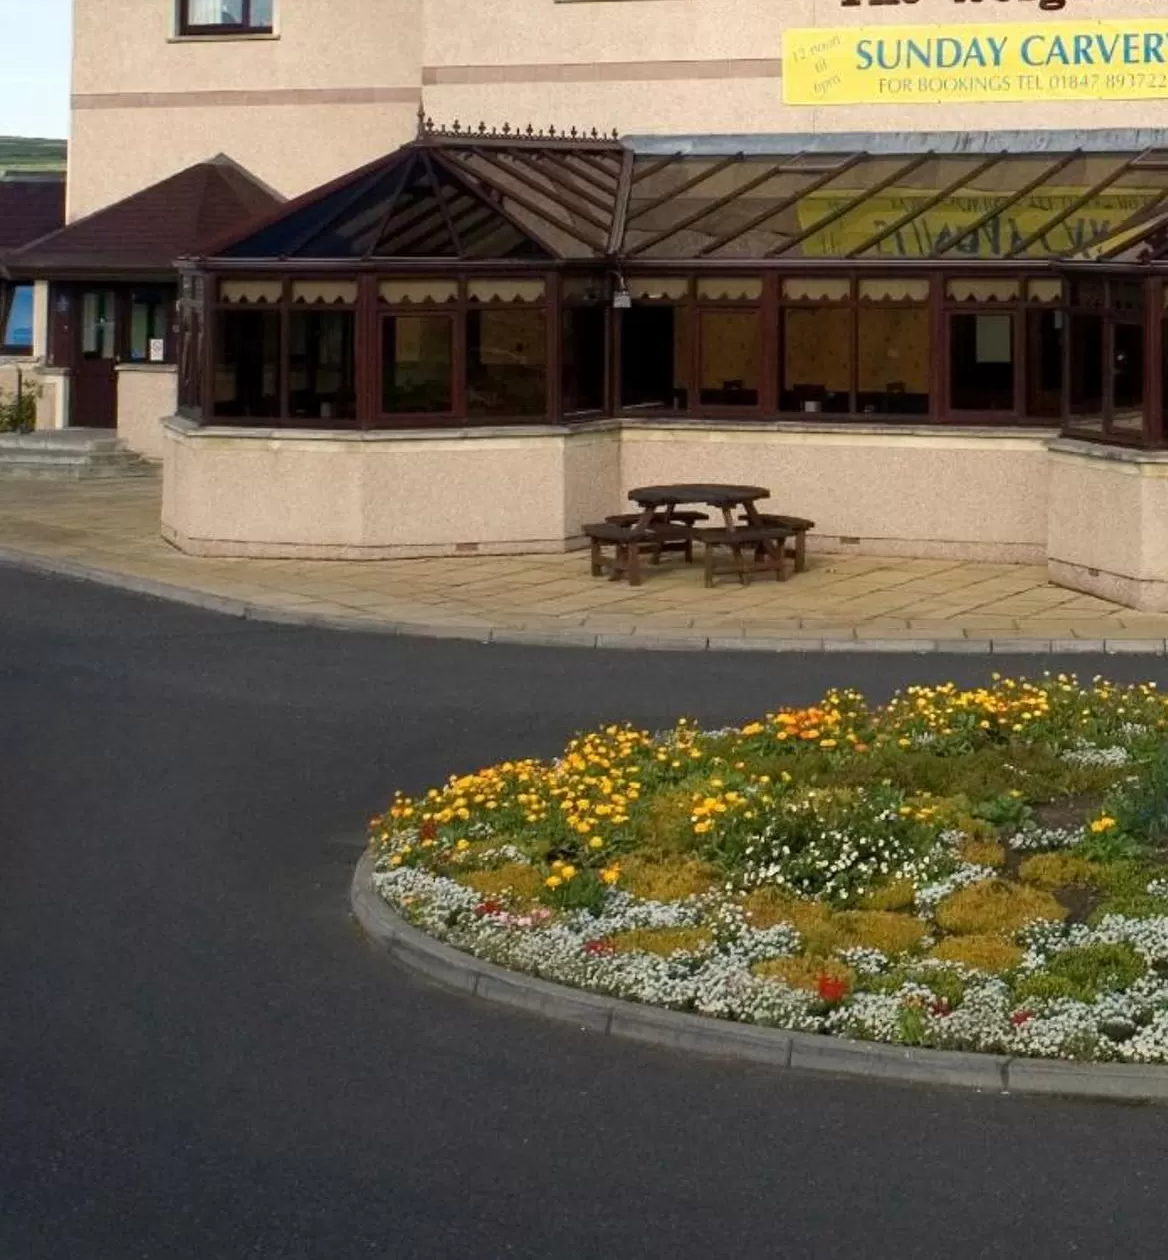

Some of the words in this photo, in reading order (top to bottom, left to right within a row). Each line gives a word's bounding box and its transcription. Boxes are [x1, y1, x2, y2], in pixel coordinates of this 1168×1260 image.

[856, 36, 1008, 70] SUNDAY
[879, 77, 912, 93] FOR
[917, 74, 1011, 92] BOOKINGS
[1017, 74, 1043, 90] TEL
[1049, 73, 1100, 90] 01847
[1106, 72, 1168, 89] 893722
